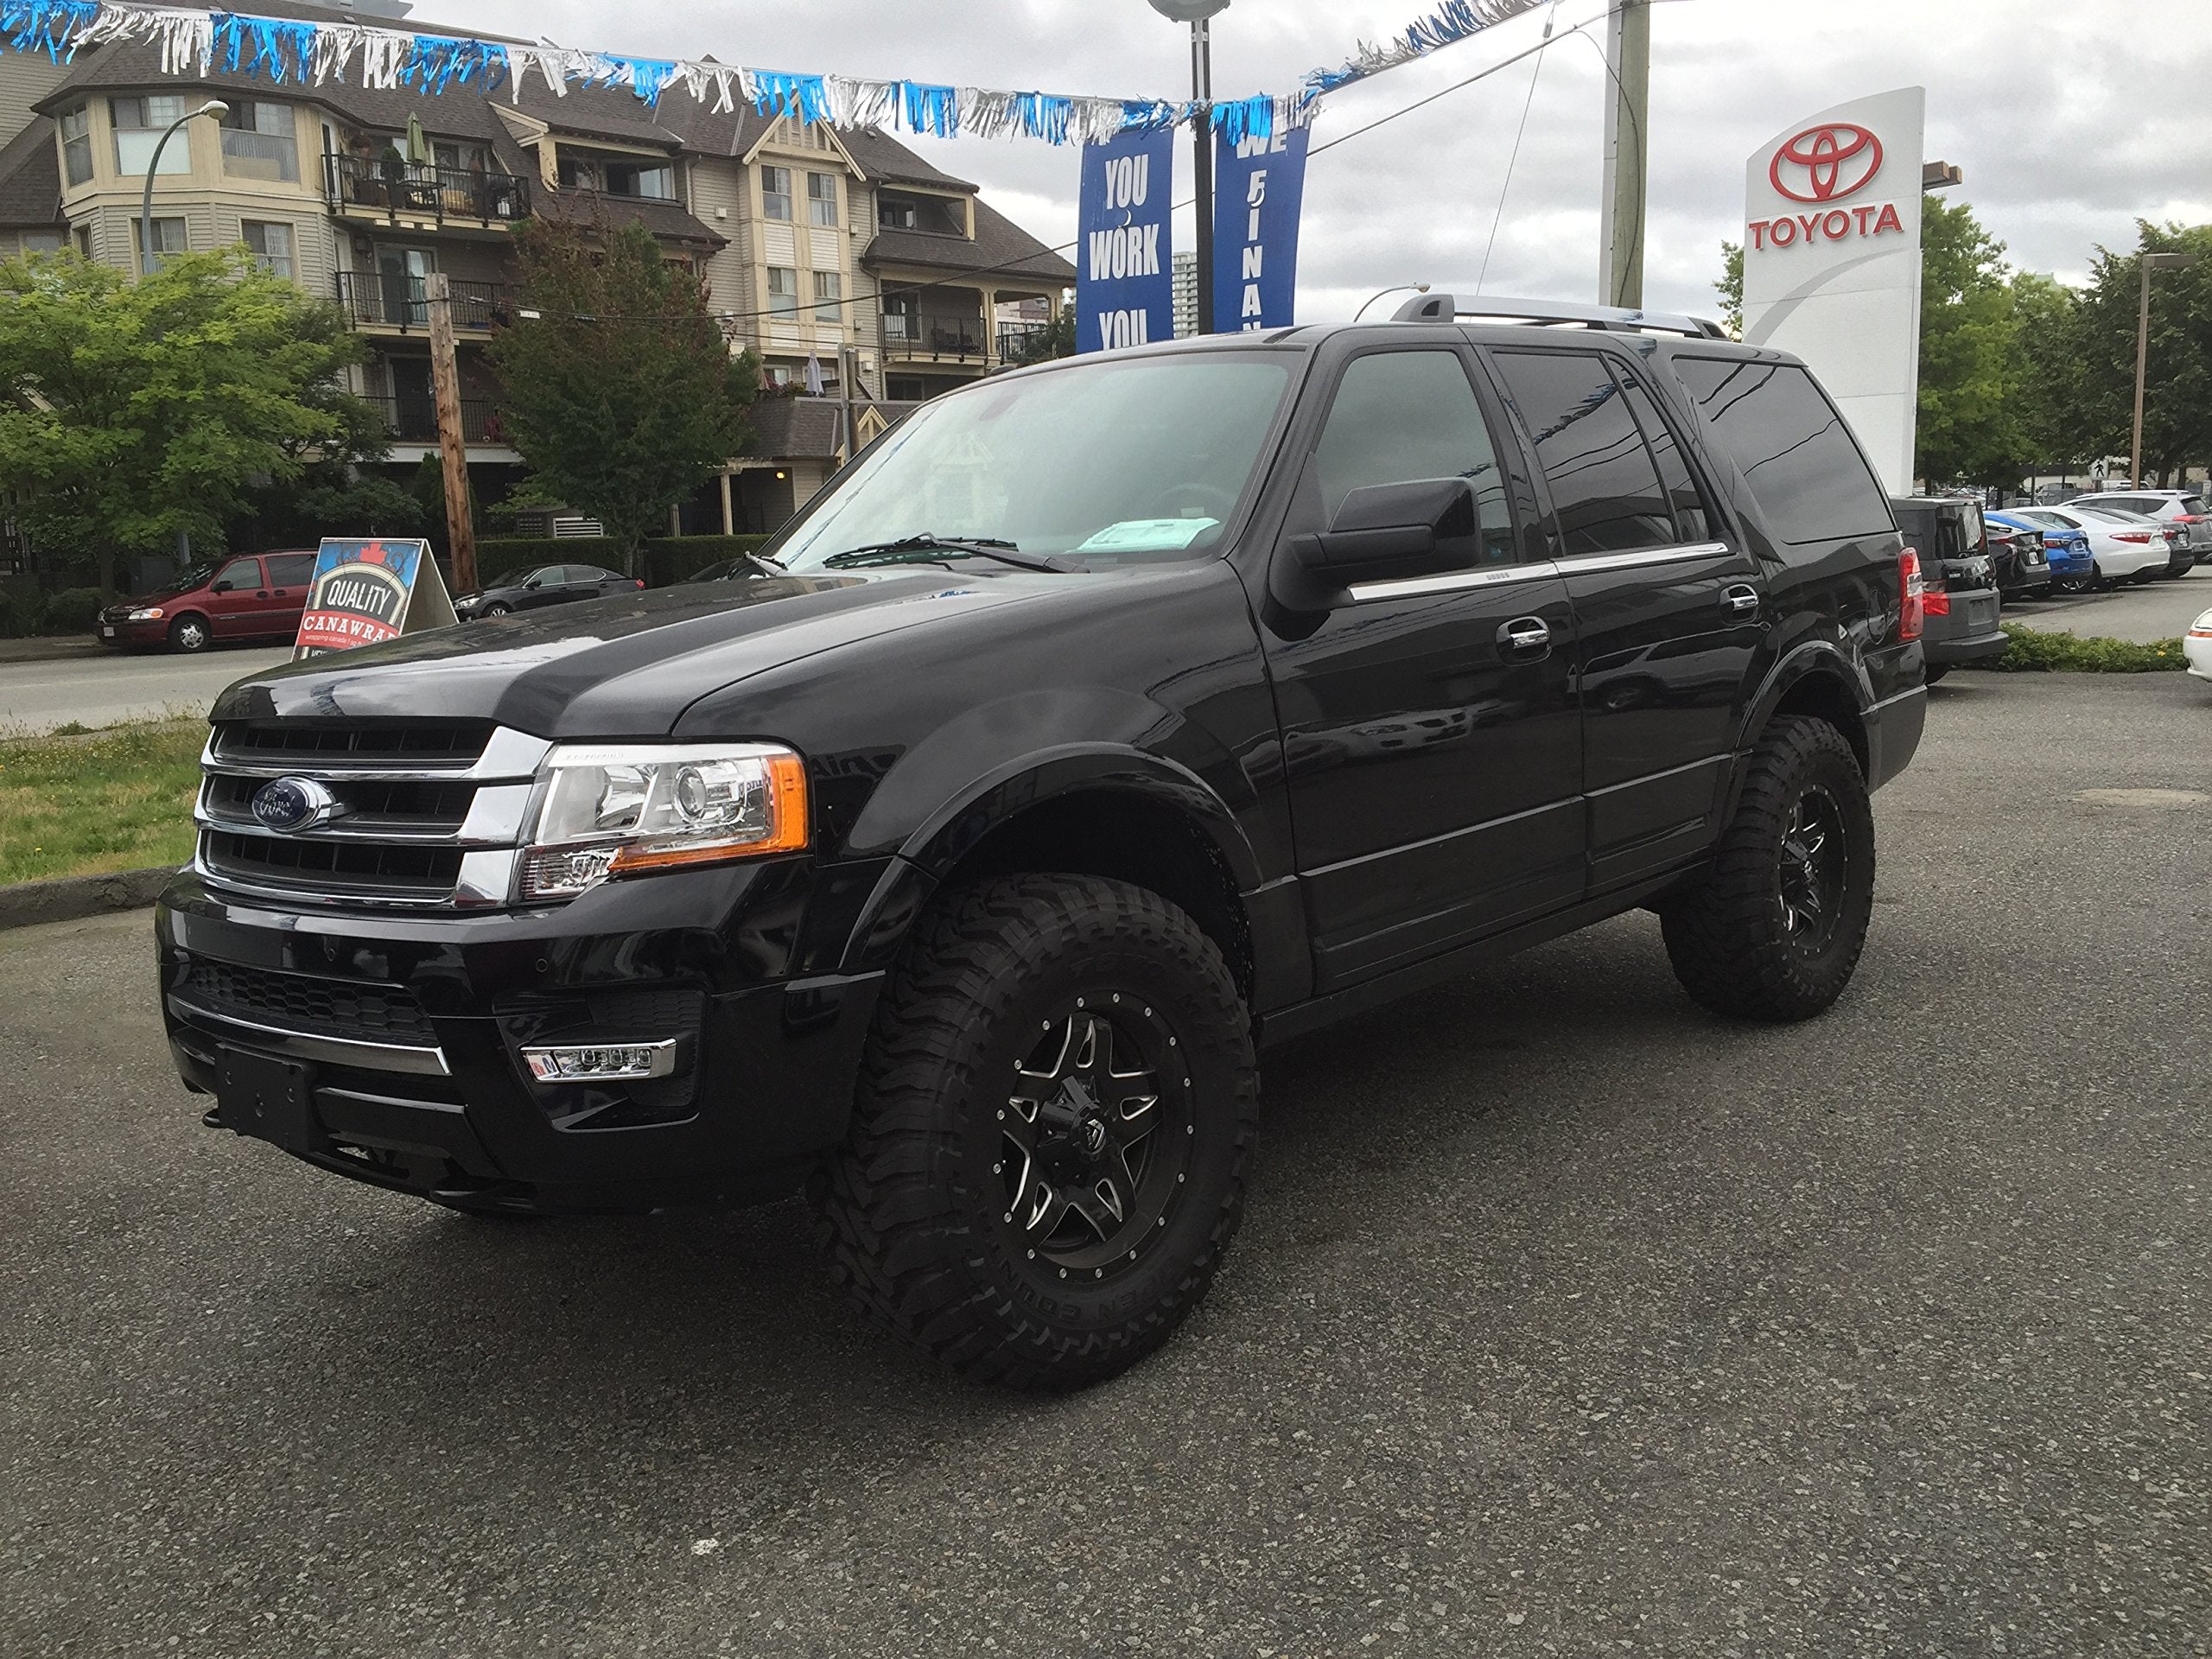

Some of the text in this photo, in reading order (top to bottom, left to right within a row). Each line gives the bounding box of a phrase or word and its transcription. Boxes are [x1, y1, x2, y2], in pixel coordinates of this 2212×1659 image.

[1236, 131, 1287, 160] WE
[1105, 154, 1149, 209] YOU
[1241, 169, 1268, 331] FINA
[1748, 203, 1904, 250] TOYOTA
[1089, 223, 1160, 282] WORK
[1098, 308, 1147, 350] YOU
[327, 579, 391, 615] QUALITY
